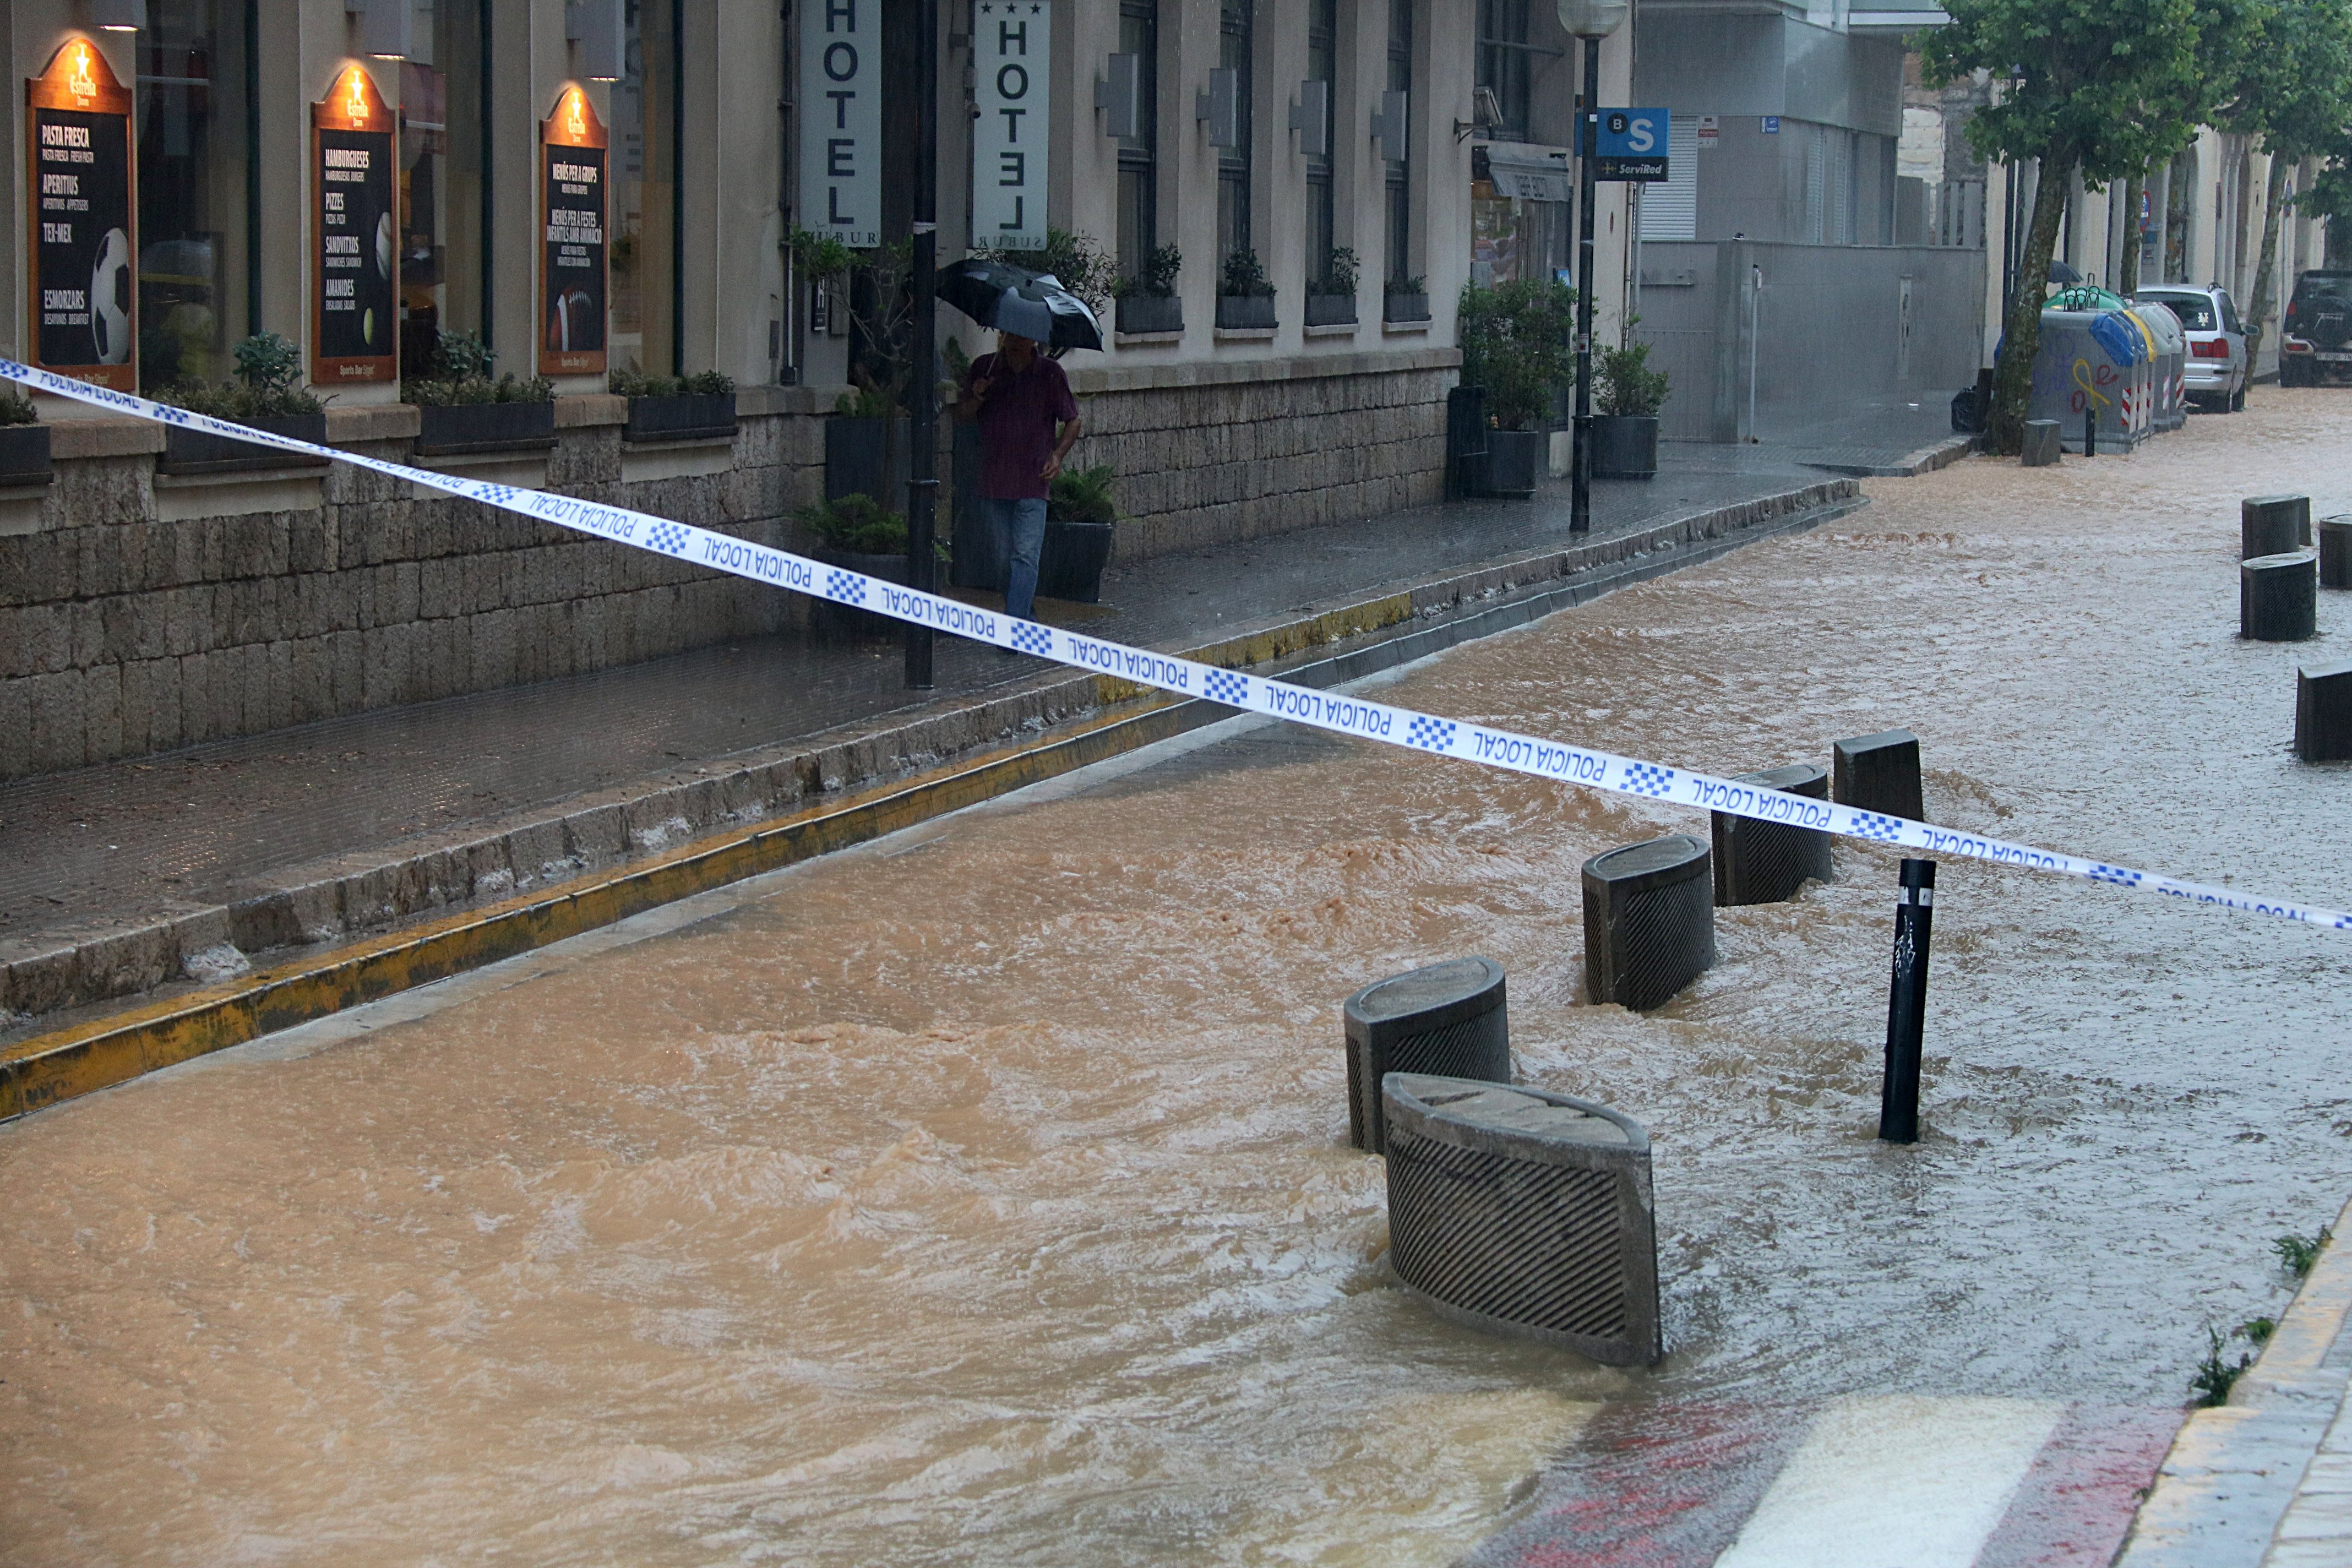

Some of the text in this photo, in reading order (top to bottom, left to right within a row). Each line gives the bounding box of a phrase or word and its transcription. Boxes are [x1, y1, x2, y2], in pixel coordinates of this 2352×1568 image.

[823, 0, 858, 225] HOTEL
[42, 124, 89, 148] PASTA FRESCA
[1613, 118, 1654, 151] B S
[325, 149, 369, 168] HAMBURGUESES
[1619, 164, 1663, 174] ServiRed
[552, 160, 597, 183] MENÚS PER A GRUPS
[43, 173, 79, 195] APERITIUS
[325, 192, 344, 210] PIZZES
[552, 206, 596, 227] MENÚS PER A FESTES
[43, 222, 72, 243] TEX-MEX
[547, 225, 602, 244] INFANTILS AMB ANIMACIÓ
[325, 236, 358, 253] SANDVITXOS
[325, 279, 354, 296] AMANIDES
[44, 290, 84, 309] ESMORZARS
[68, 313, 89, 325] BREAKFAST
[530, 494, 639, 538] POLICIA LOCAL
[704, 537, 813, 588] POLICIA LOCAL
[881, 587, 995, 639] POLICIA LOCAL
[1068, 638, 1188, 688] POLICIA LOCAL
[1266, 685, 1392, 736] POLICIA LOCAL
[1473, 732, 1607, 781] POLICIA LOCAL
[1692, 779, 1832, 827] POLICIA LOCAL
